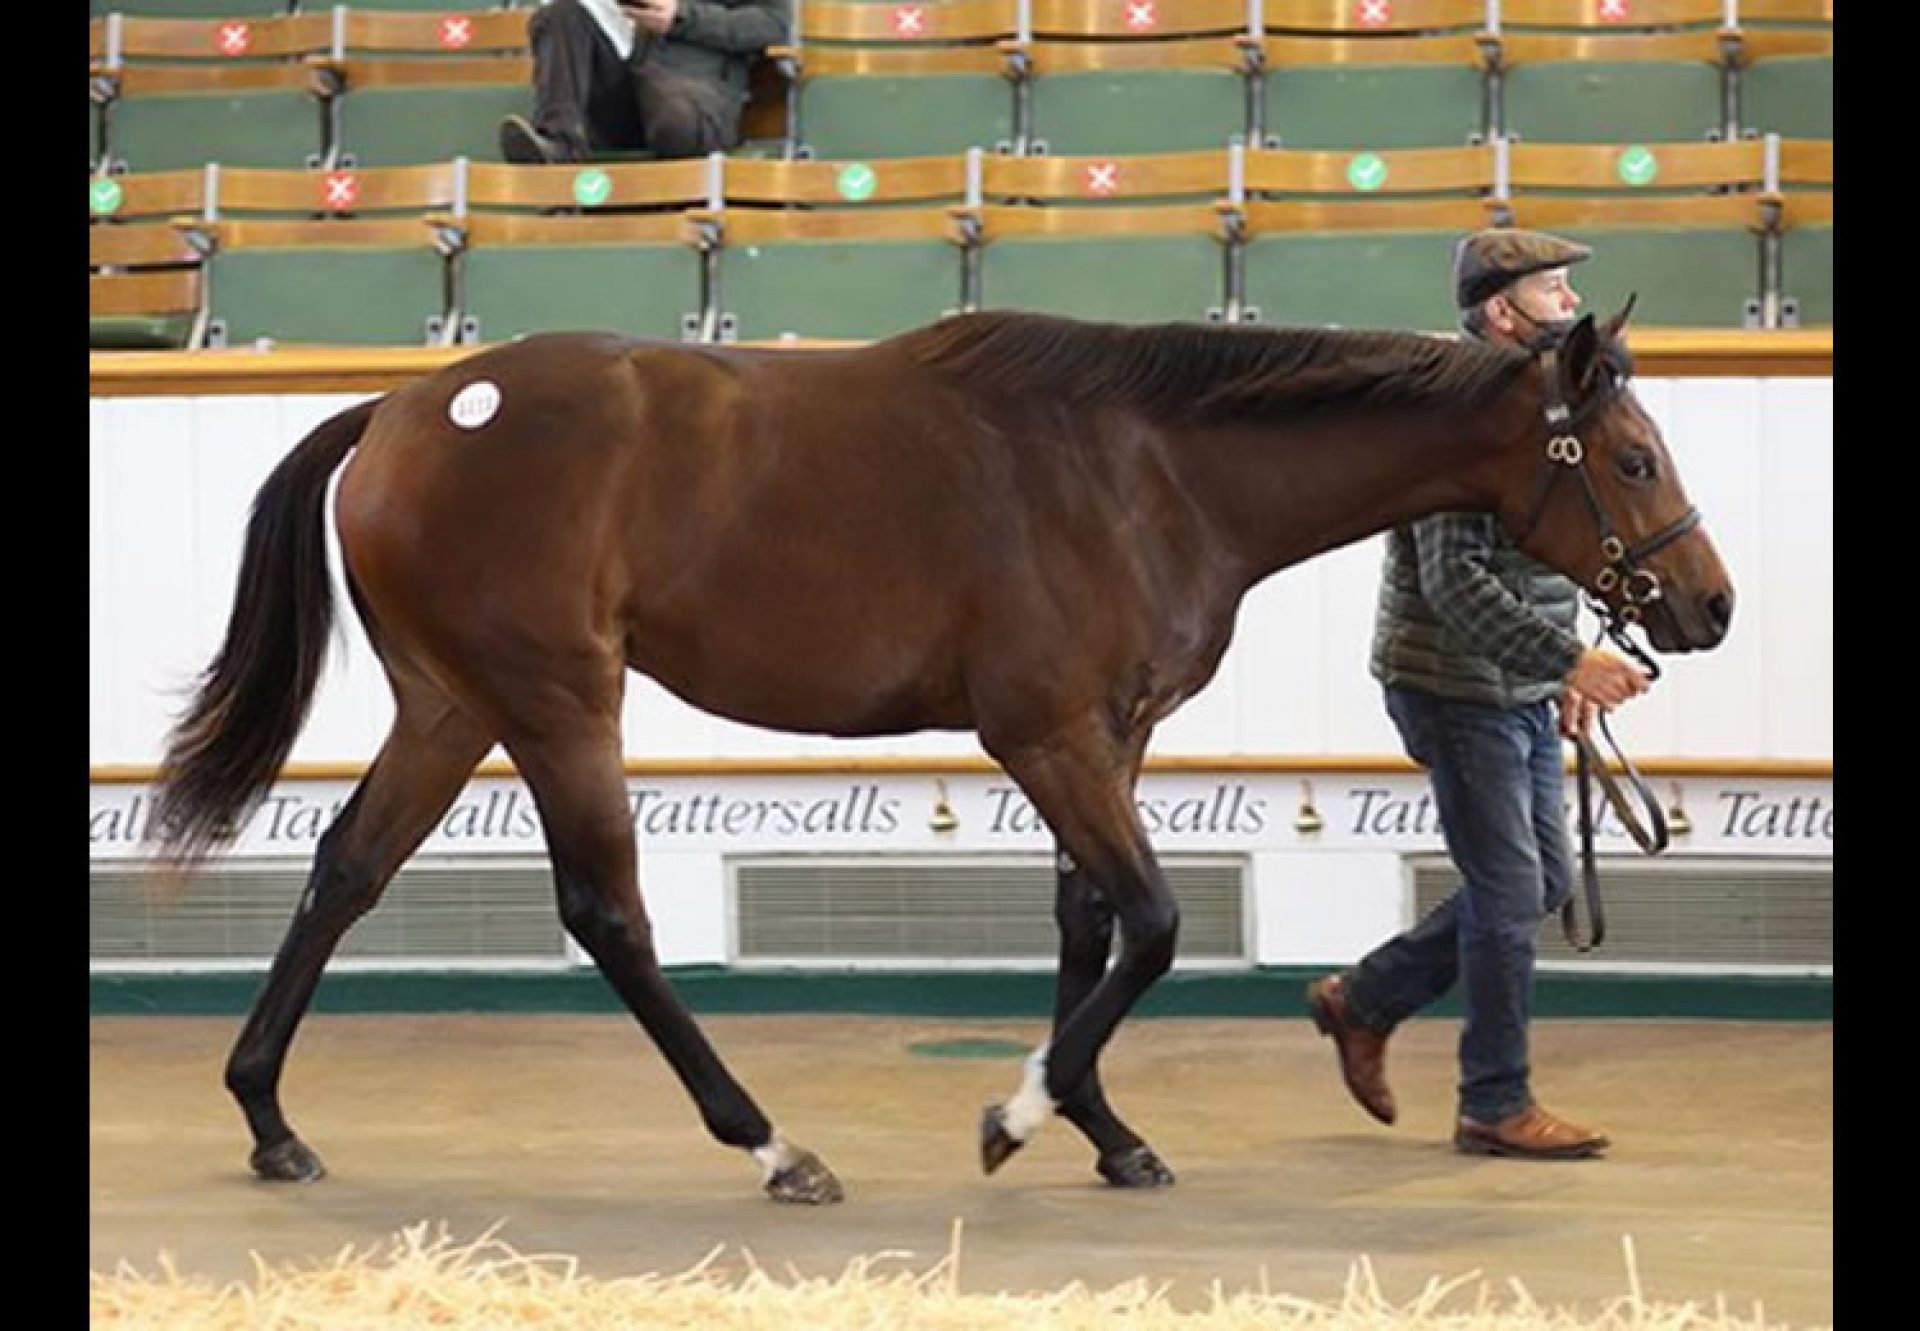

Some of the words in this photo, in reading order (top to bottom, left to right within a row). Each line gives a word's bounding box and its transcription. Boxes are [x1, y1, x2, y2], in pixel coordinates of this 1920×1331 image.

[267, 791, 536, 840] Taalls
[627, 785, 902, 835] Tattersalls
[984, 784, 1267, 834] Tasalls
